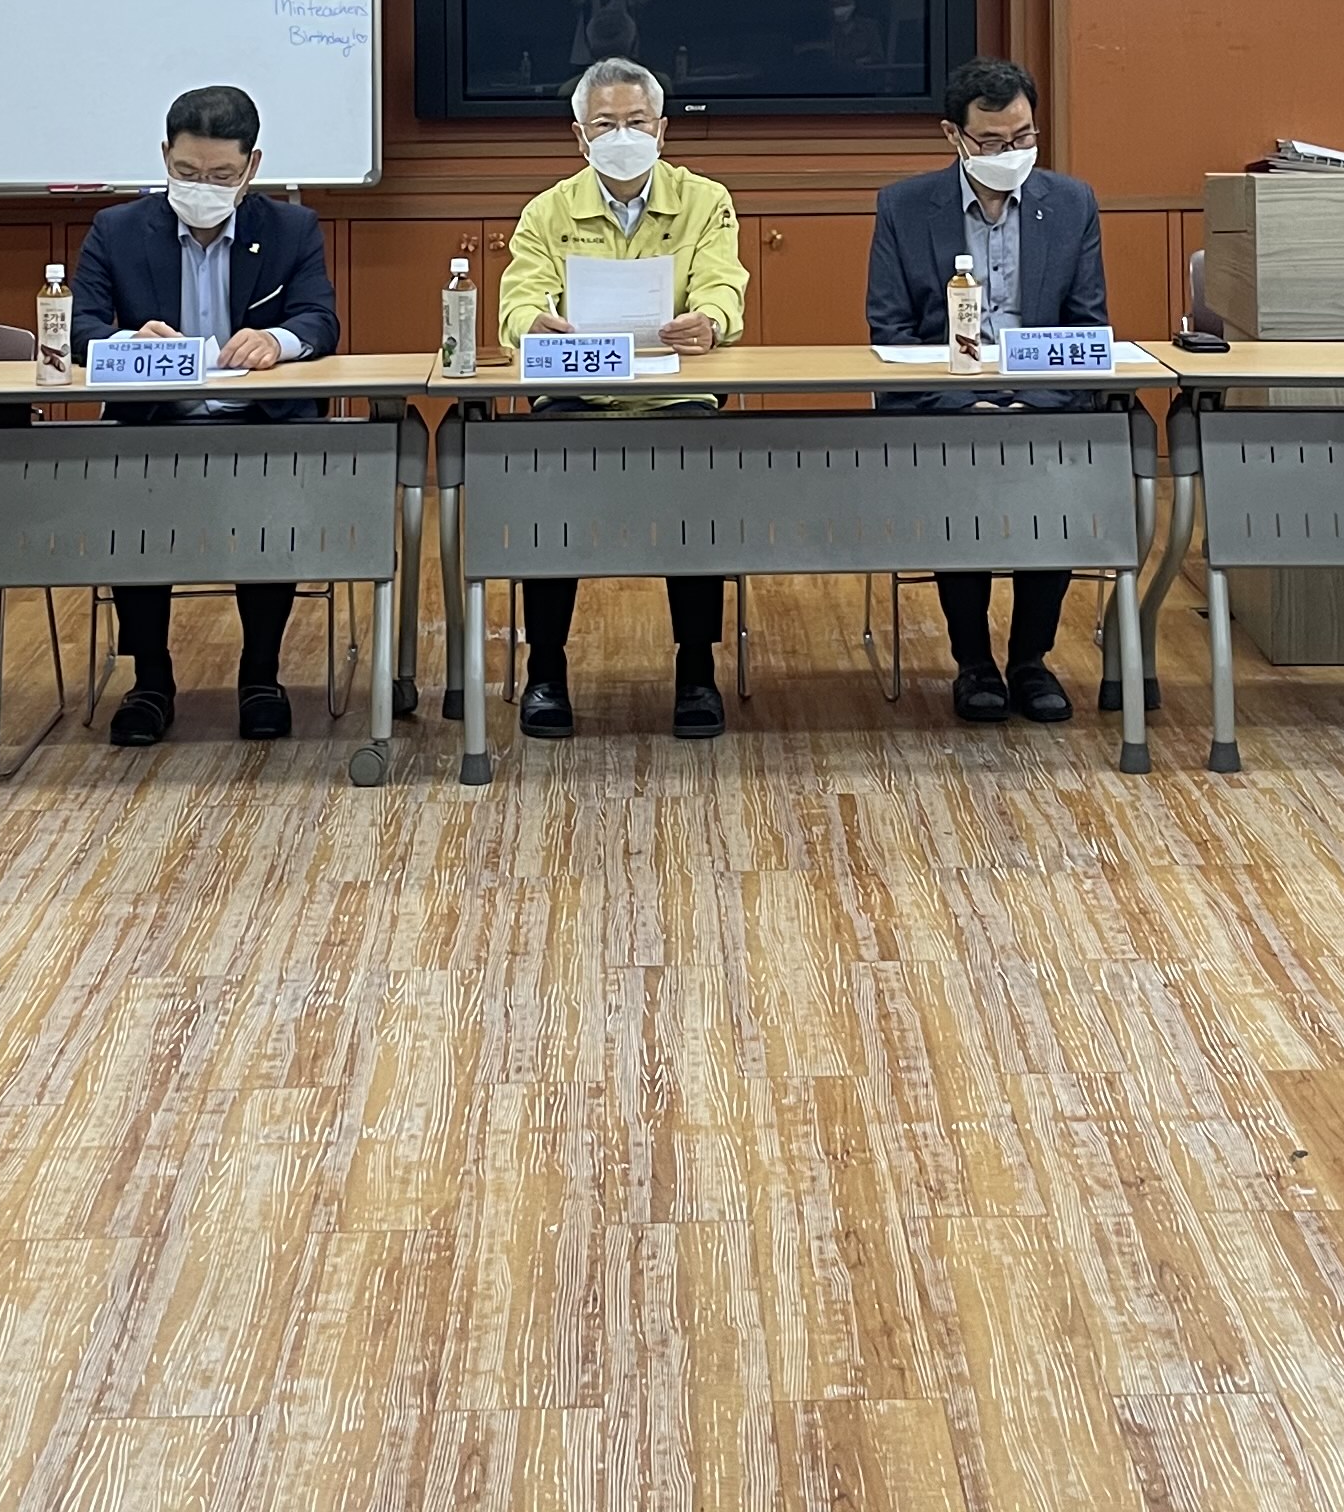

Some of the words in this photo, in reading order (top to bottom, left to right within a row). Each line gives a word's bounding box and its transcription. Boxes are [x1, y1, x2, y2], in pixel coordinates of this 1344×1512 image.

[95, 358, 126, 372] 교육장
[134, 353, 195, 377] 이수경
[561, 349, 623, 373] 김정수
[1047, 342, 1108, 366] 심환무
